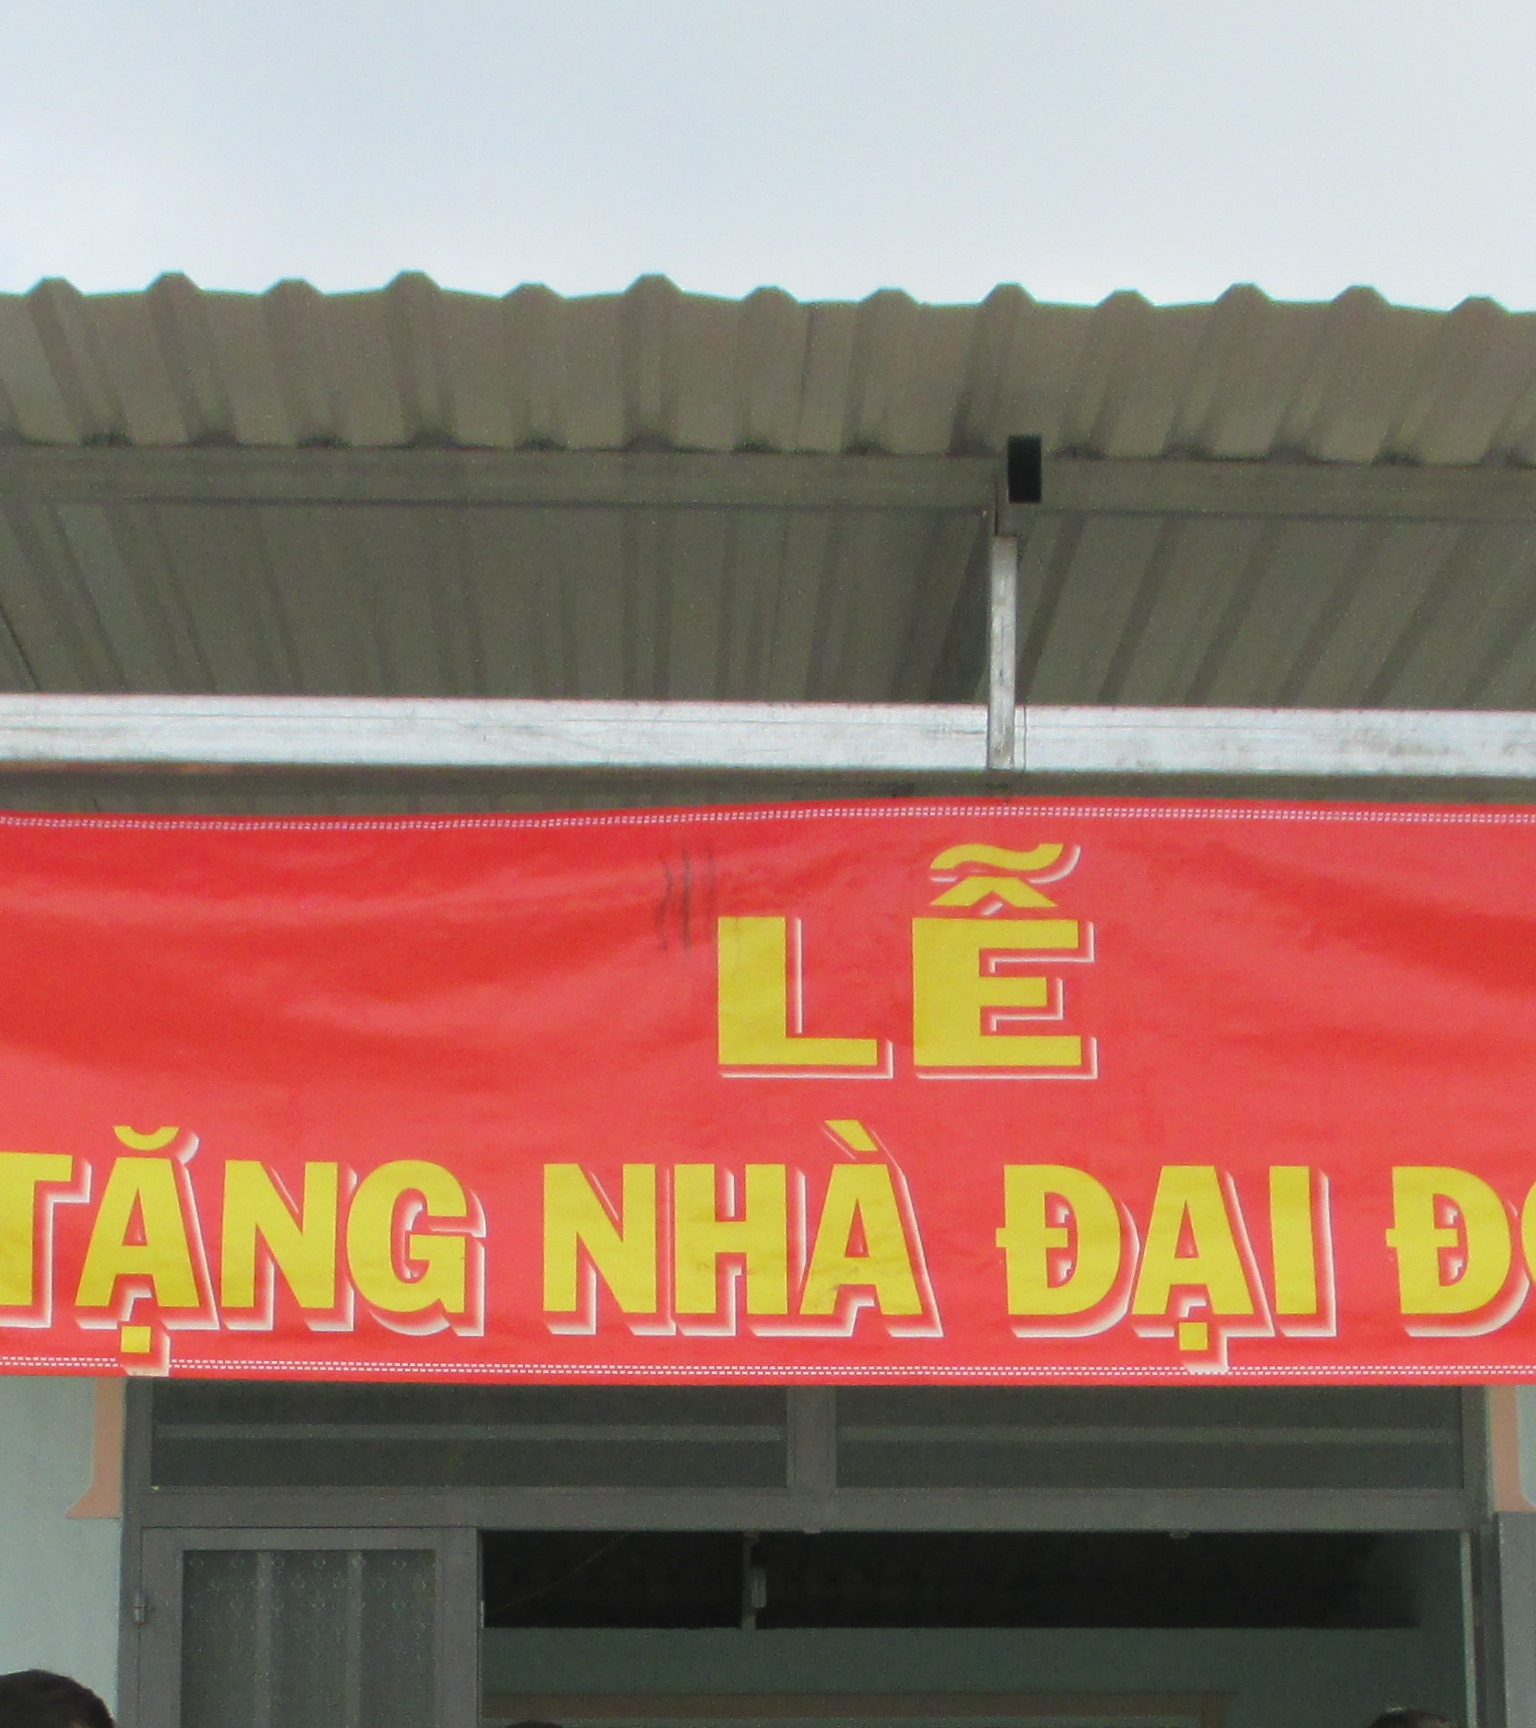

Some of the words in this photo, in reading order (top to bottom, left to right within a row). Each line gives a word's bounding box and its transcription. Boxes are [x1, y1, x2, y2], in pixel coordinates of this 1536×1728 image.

[720, 846, 1089, 1075] LỄ
[546, 1122, 930, 1324] NHÀ
[998, 1166, 1325, 1359] ĐẠI
